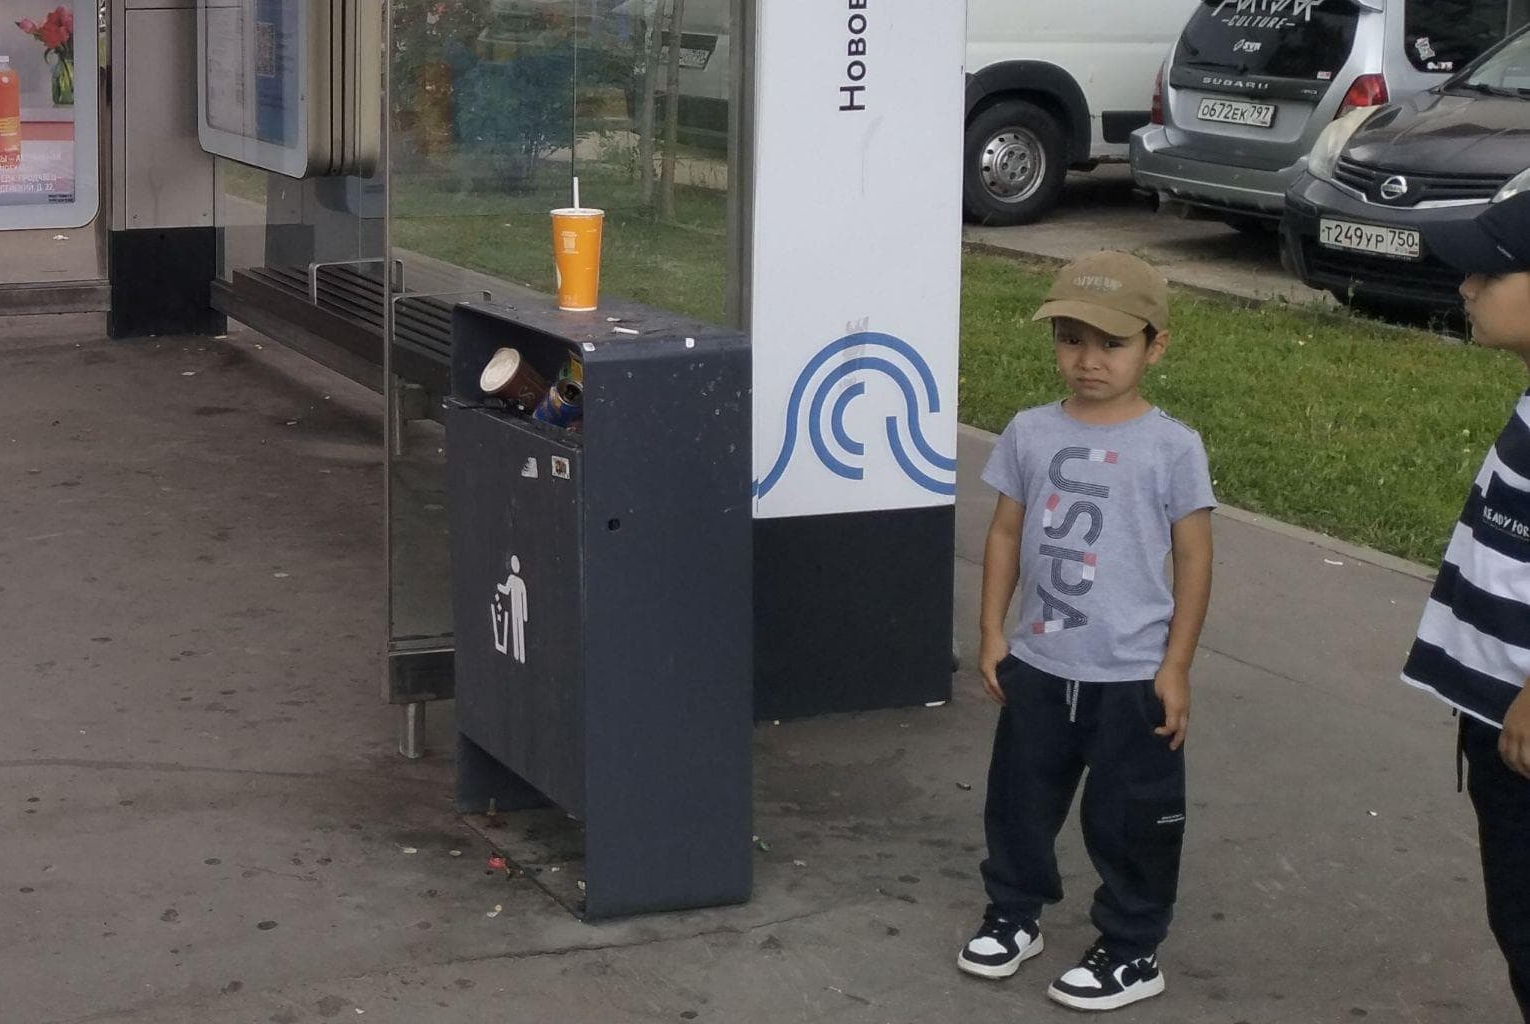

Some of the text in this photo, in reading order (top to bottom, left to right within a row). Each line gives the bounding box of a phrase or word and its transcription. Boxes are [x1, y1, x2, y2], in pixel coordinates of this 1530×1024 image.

[1202, 77, 1269, 90] SUBARU
[1482, 504, 1512, 529] READY
[1031, 446, 1119, 635] USPA
